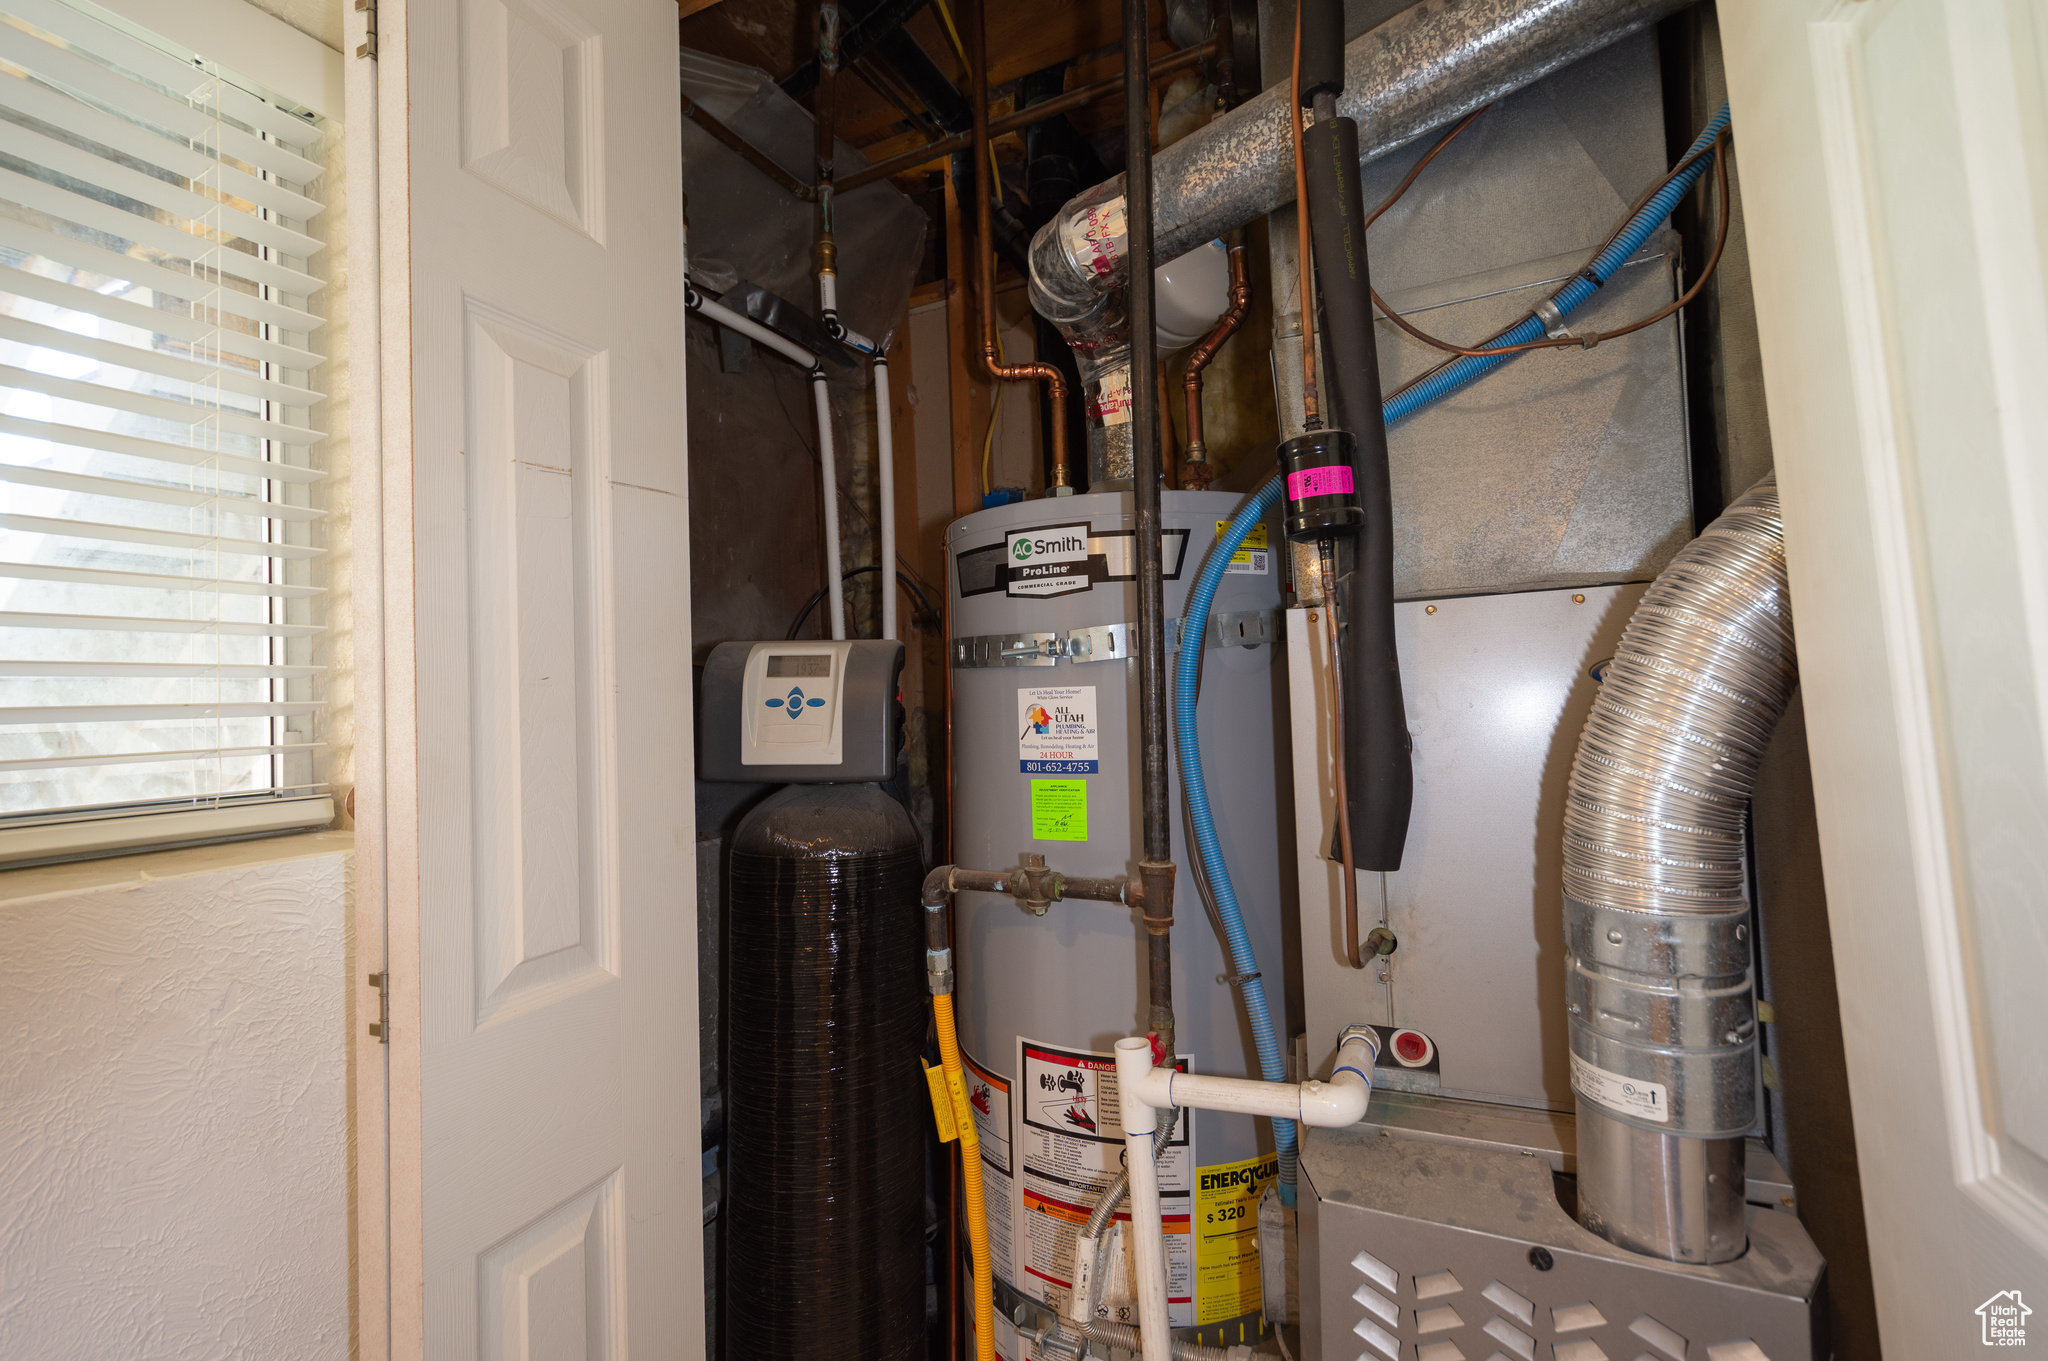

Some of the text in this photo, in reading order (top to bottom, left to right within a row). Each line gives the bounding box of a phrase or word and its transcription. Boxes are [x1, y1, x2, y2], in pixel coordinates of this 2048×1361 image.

[1022, 565, 1067, 576] ProLine
[1055, 714, 1084, 722] UTAH
[1027, 762, 1089, 772] 801-652-4755
[1088, 1062, 1116, 1072] DANGE
[1207, 1206, 1245, 1224] $ 320
